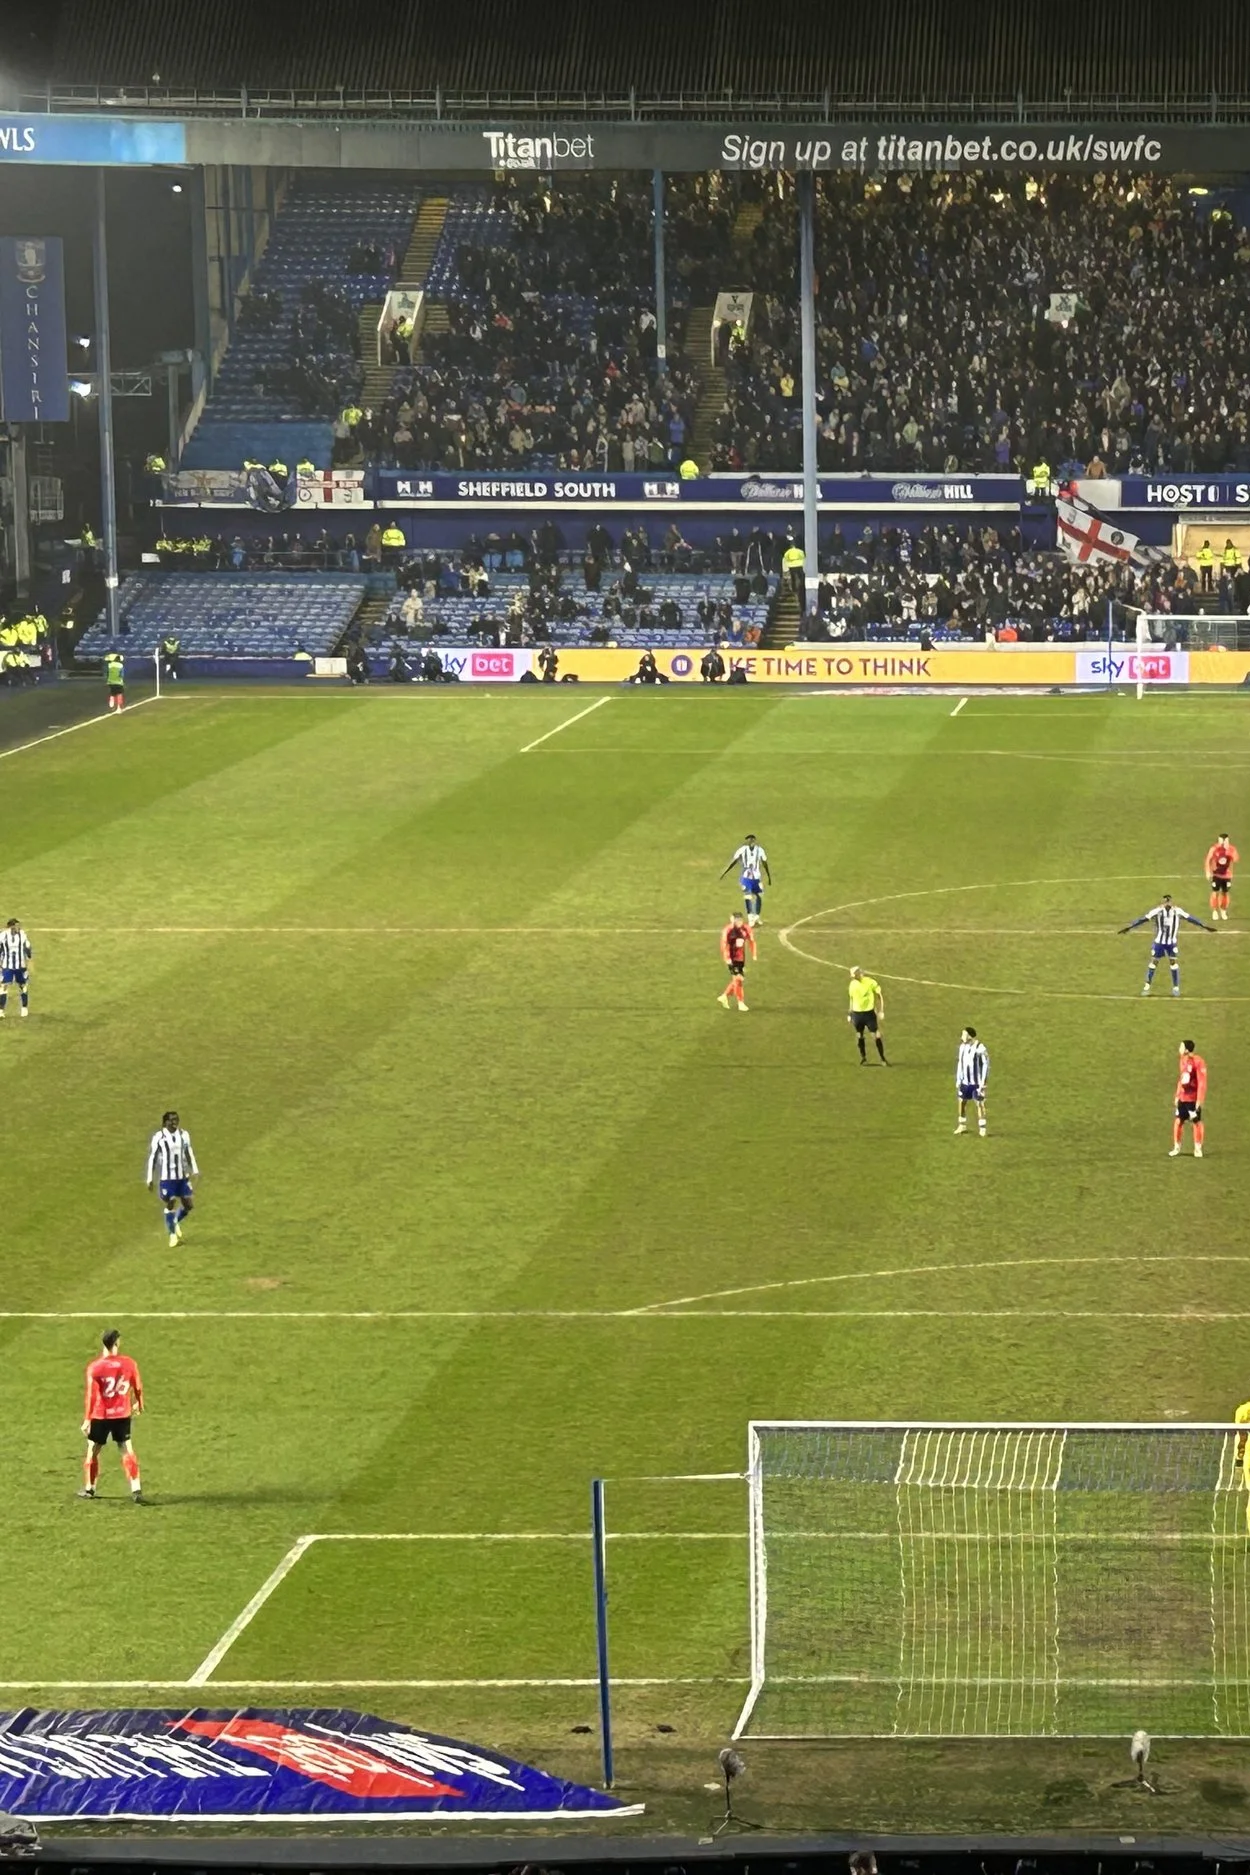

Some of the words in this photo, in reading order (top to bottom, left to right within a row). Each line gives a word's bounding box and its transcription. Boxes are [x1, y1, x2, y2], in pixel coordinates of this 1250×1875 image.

[483, 132, 594, 158] Titanbet
[722, 135, 784, 169] Sign
[795, 140, 831, 169] up
[841, 136, 868, 161] at
[877, 134, 1162, 162] titanbet.co.uk/swfc
[26, 285, 42, 420] CHANSIRI
[458, 481, 547, 497] SHEFFIELD
[554, 482, 615, 498] SOUTH
[944, 484, 974, 499] HILL
[1147, 484, 1206, 502] HOST
[475, 655, 513, 672] bet
[763, 657, 816, 675] TIME
[820, 657, 853, 675] TO
[858, 657, 931, 676] THINK
[1091, 657, 1124, 677] sky
[103, 1374, 130, 1398] 26
